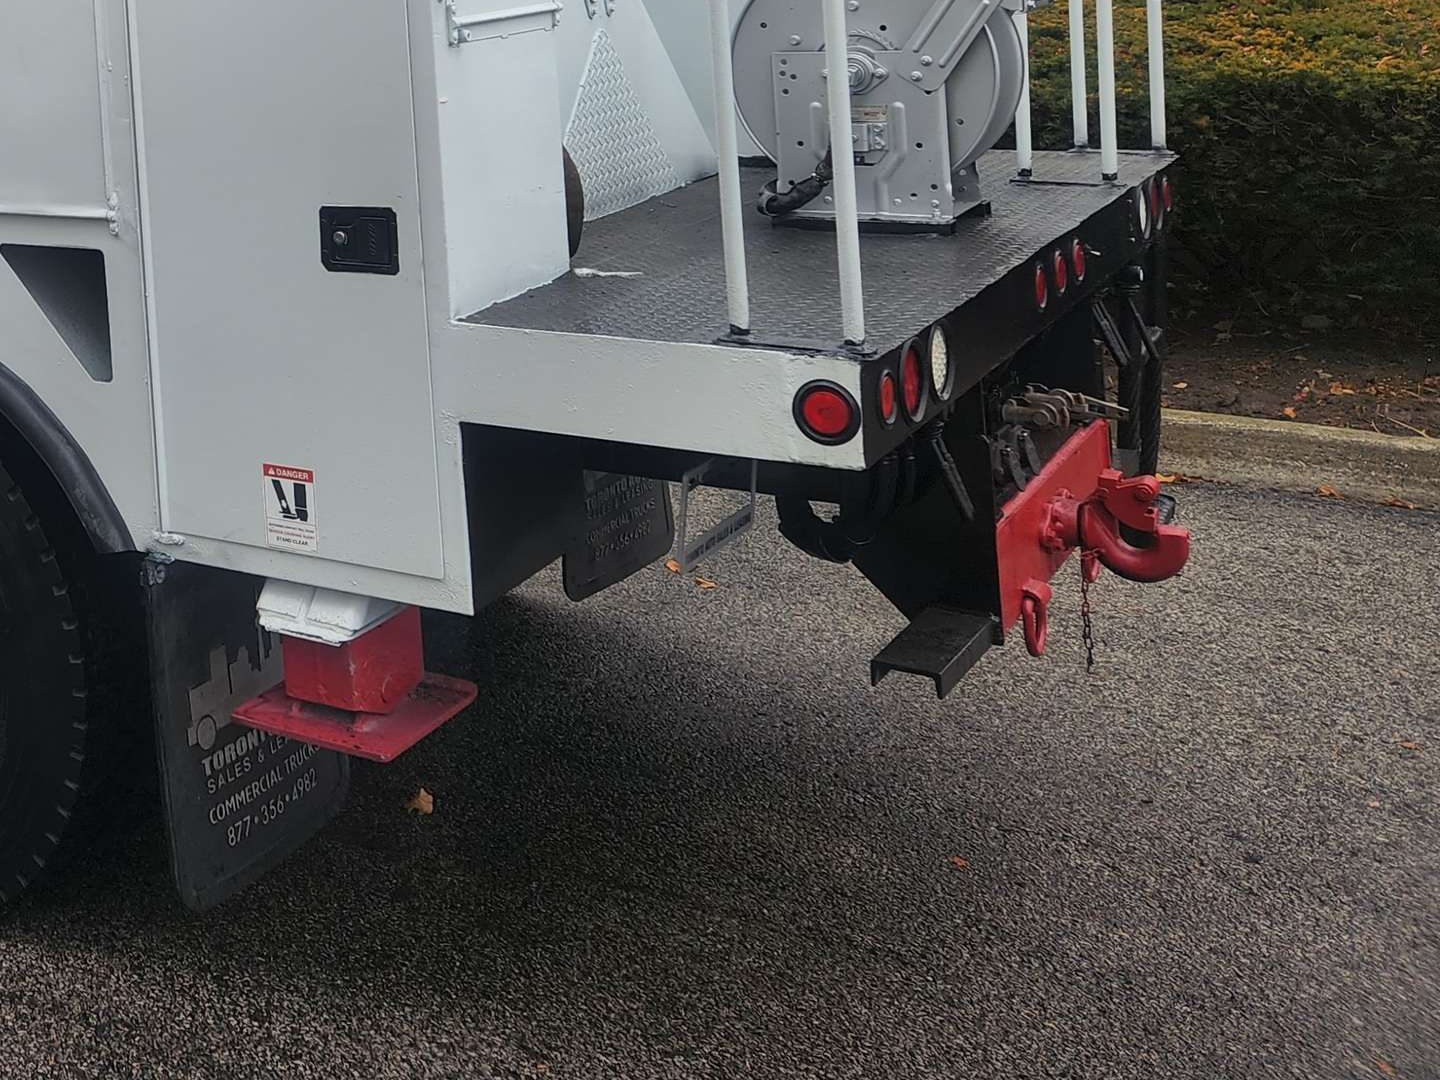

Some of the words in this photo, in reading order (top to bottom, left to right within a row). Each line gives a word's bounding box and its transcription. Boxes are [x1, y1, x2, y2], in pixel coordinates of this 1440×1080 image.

[275, 468, 309, 480] DANGER
[202, 727, 273, 777] TORON
[208, 756, 252, 794] SALES
[257, 749, 265, 764] &
[209, 765, 284, 825] COMMERCIAL
